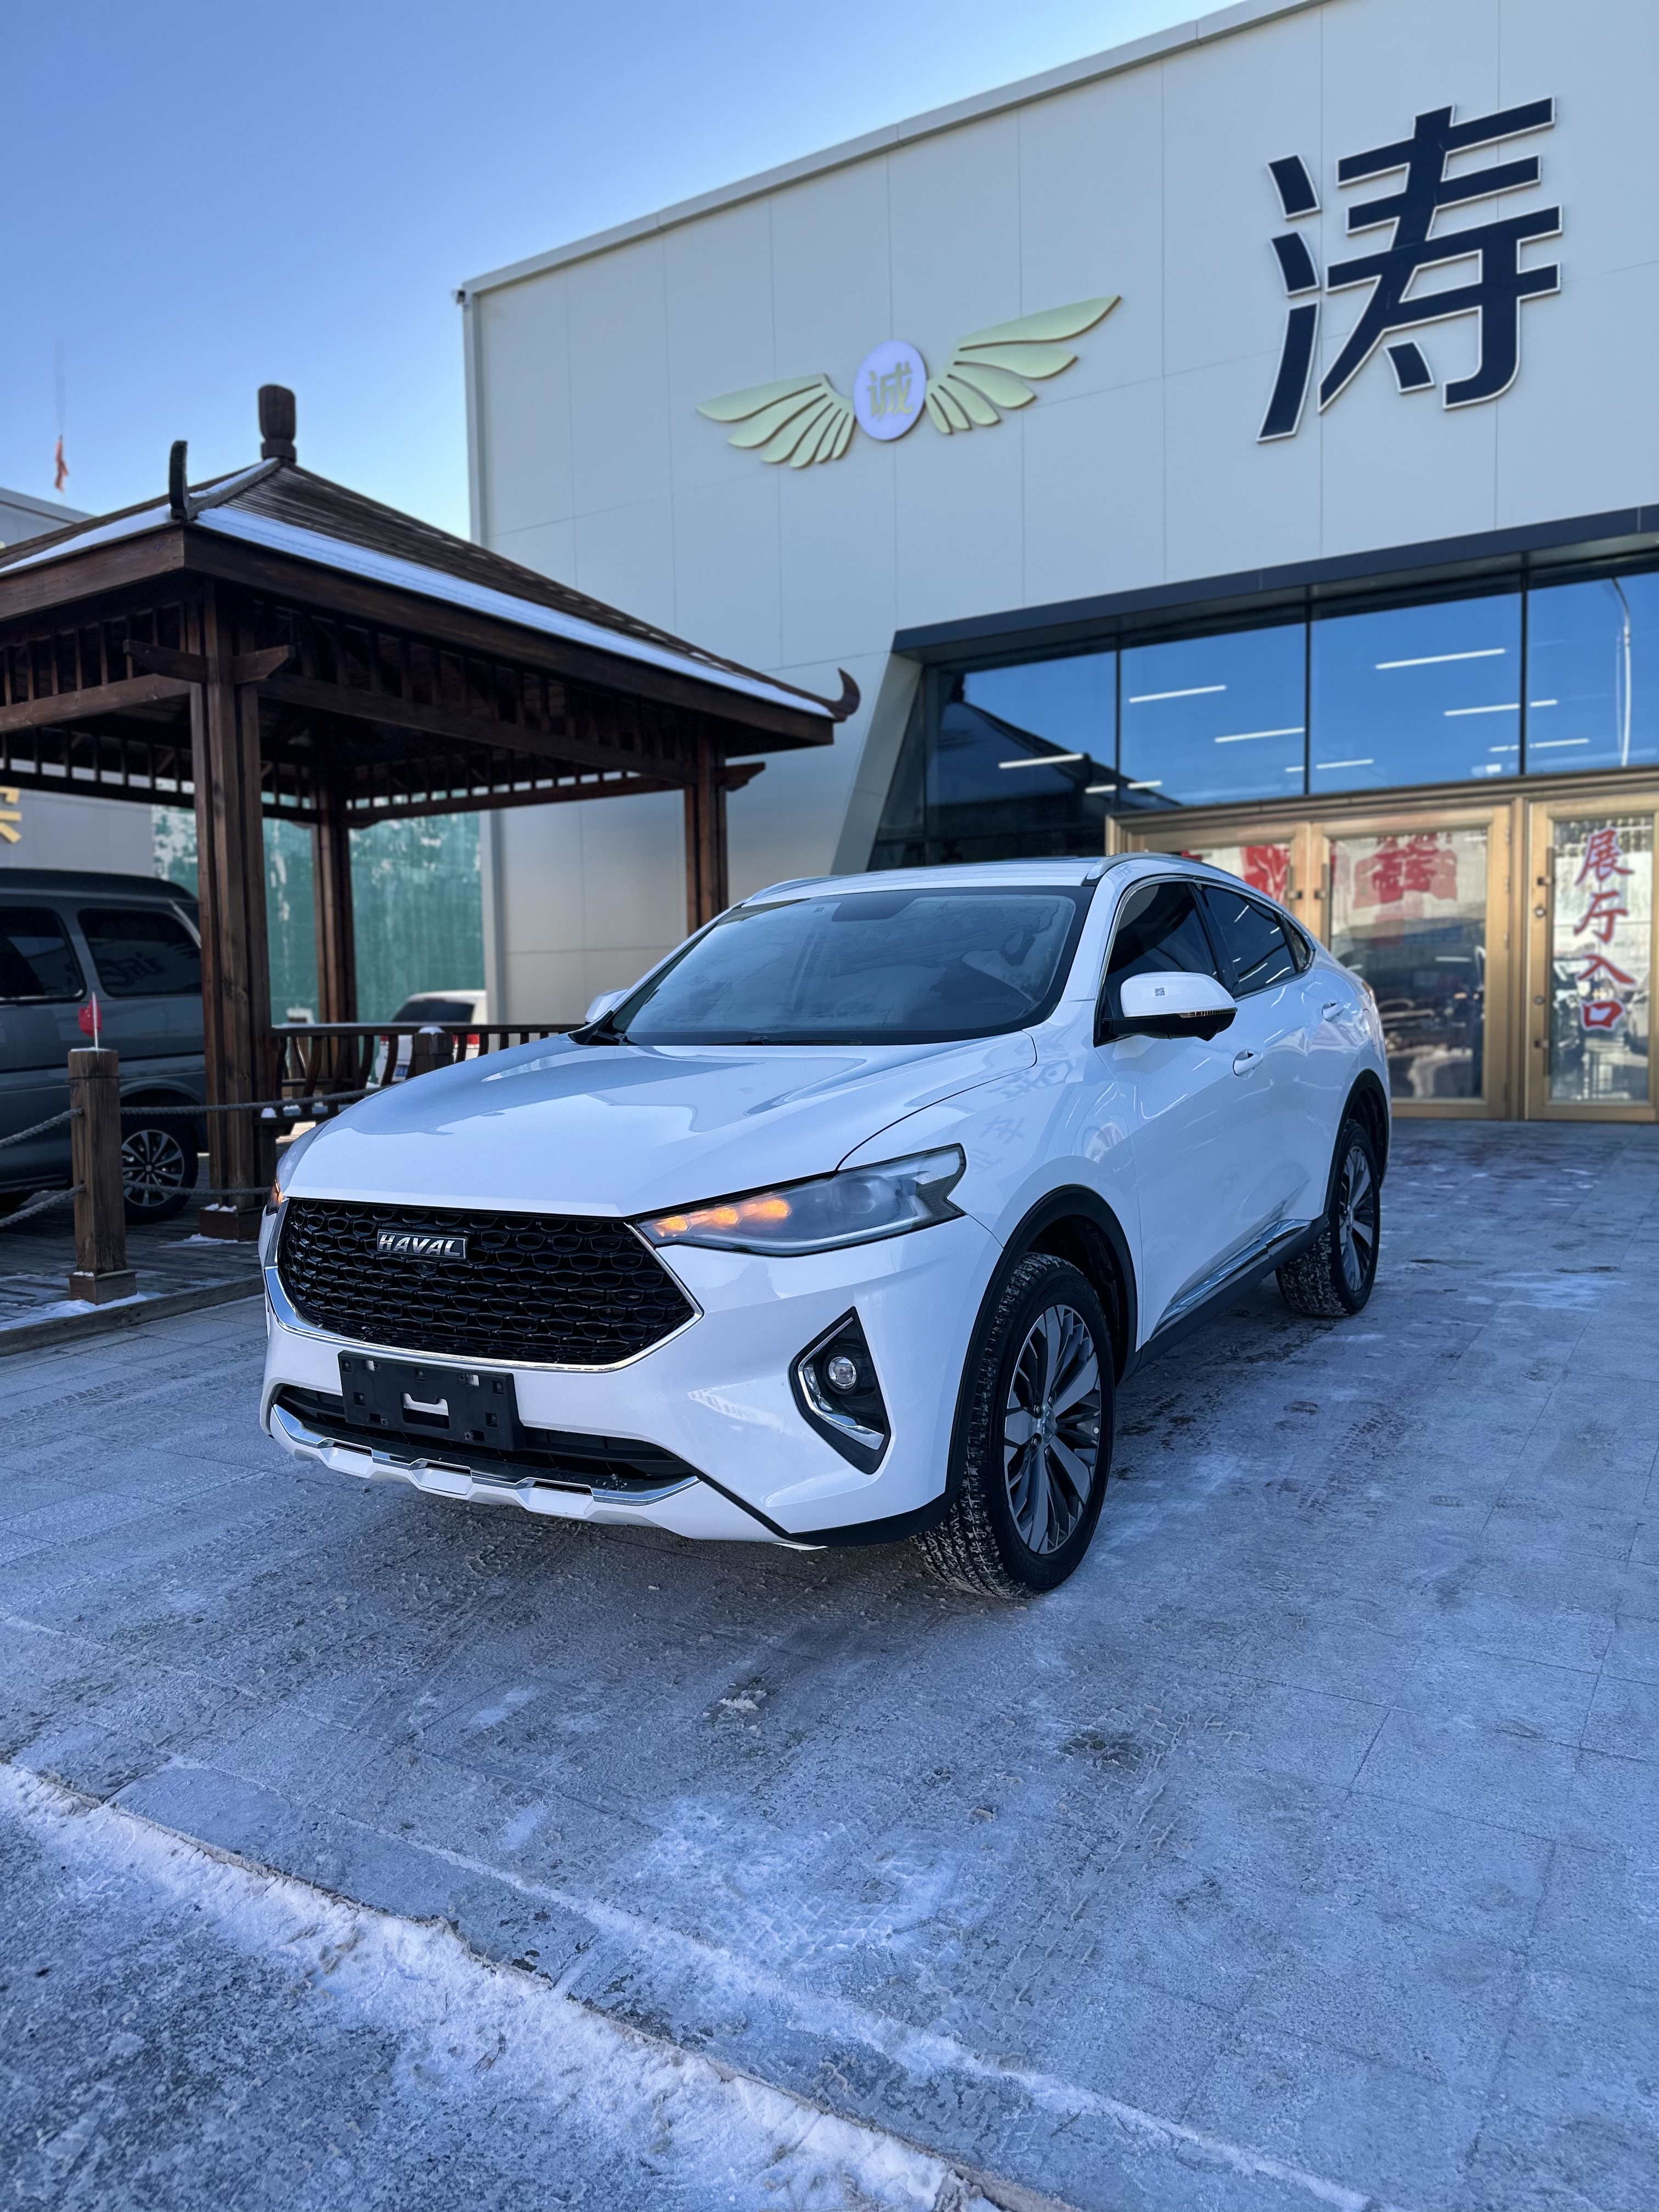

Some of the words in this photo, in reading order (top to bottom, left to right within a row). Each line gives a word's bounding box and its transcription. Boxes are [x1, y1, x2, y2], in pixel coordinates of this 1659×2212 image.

[1256, 95, 1562, 443] 涛
[866, 361, 914, 421] 诚
[1573, 827, 1637, 1029] 展厅入口
[379, 1234, 461, 1257] HAVAL
